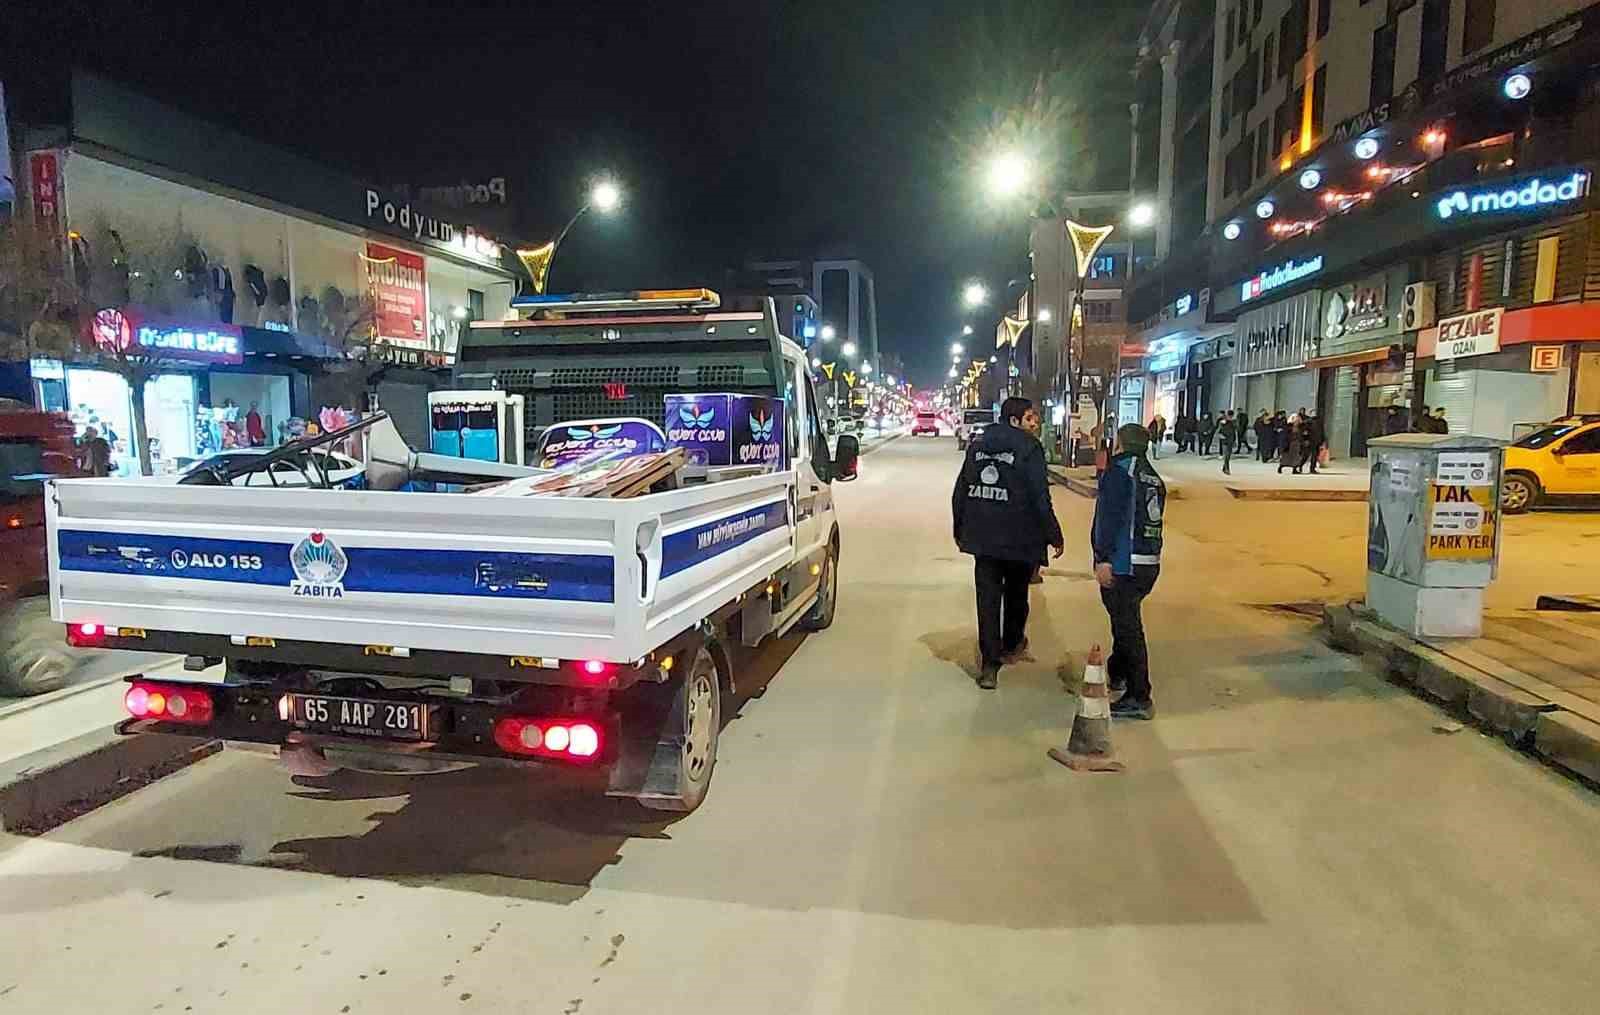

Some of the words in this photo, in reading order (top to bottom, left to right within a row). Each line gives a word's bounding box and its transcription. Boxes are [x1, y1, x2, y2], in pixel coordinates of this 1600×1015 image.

[366, 190, 455, 241] Podyum
[1452, 340, 1476, 355] OZAN
[1540, 350, 1554, 366] E
[1430, 534, 1462, 549] PARK
[189, 552, 226, 569] ALO
[230, 553, 263, 570] 153
[293, 583, 343, 599] ZABITA
[305, 699, 329, 722] 65
[340, 701, 376, 726] AAP
[384, 705, 419, 730] 281
